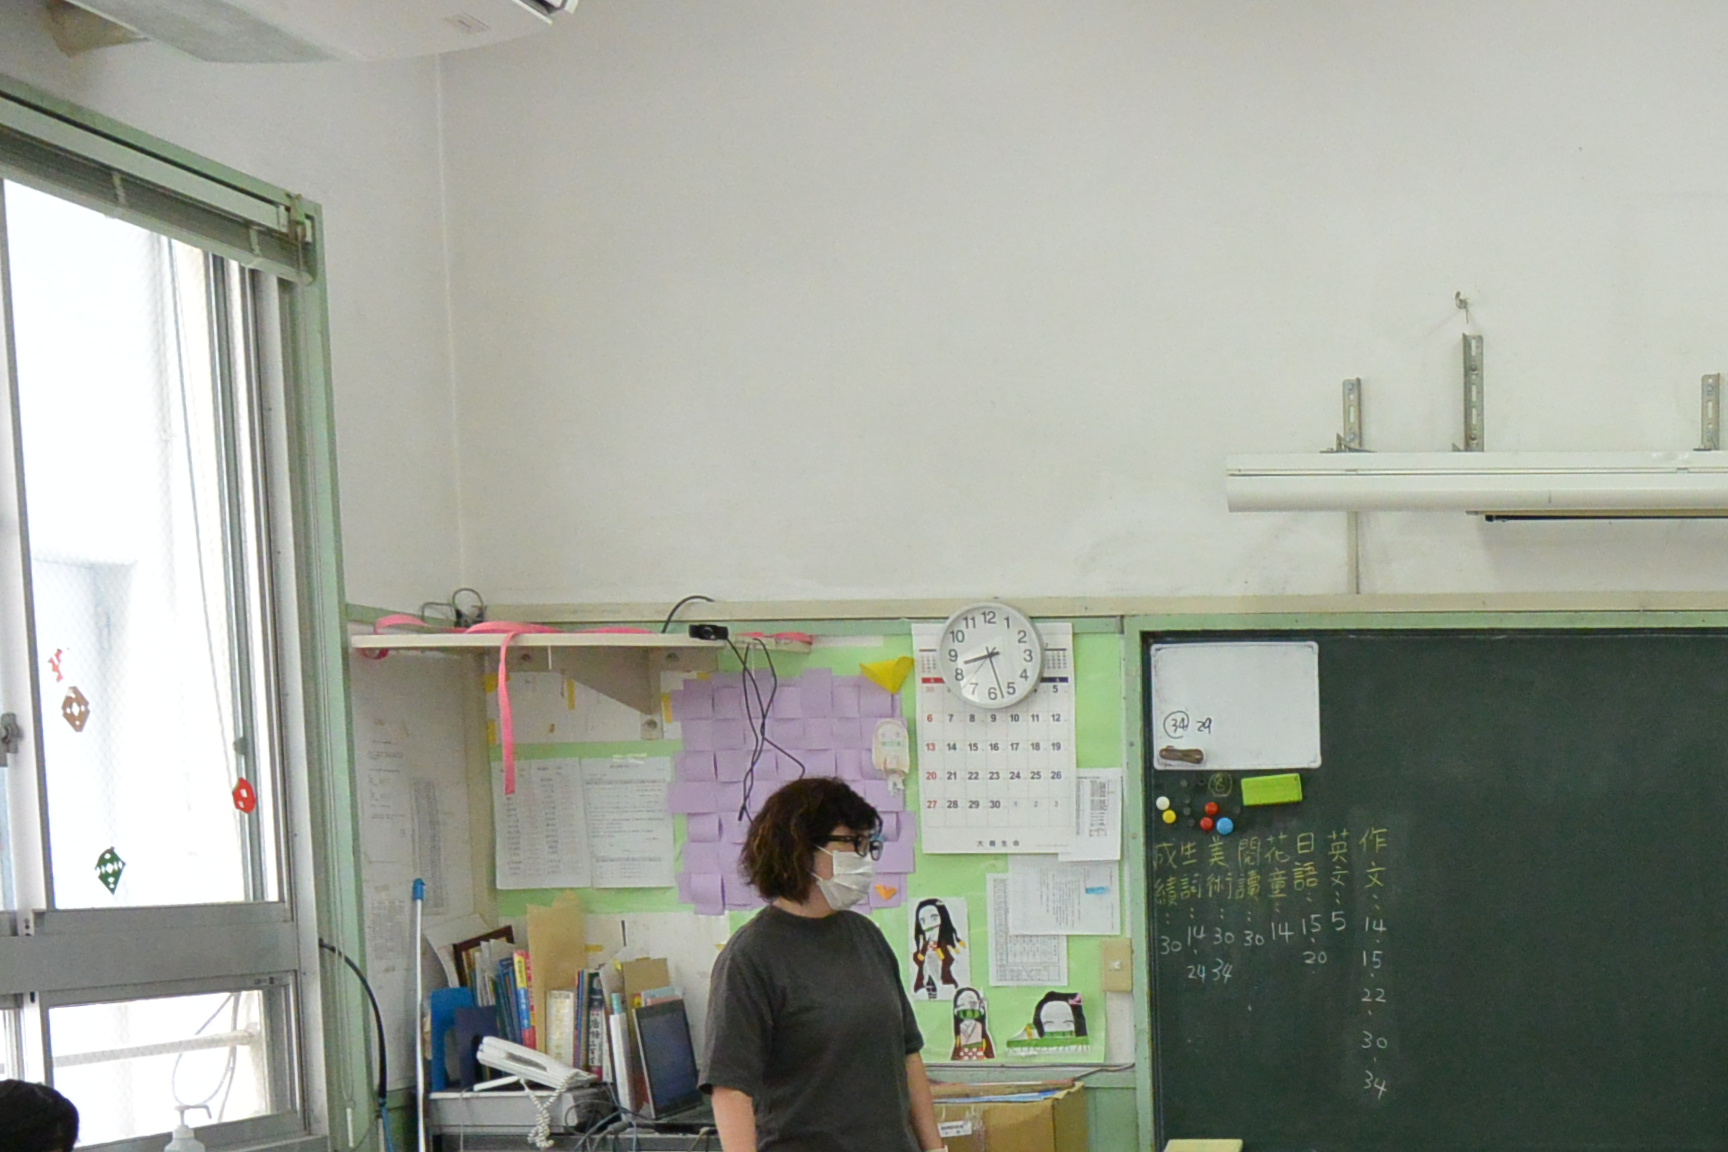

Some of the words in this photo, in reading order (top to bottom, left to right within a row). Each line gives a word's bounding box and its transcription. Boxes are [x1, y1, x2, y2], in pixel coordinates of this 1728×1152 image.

[963, 616, 976, 629] 11
[981, 611, 996, 624] 12
[1004, 616, 1010, 629] 1
[950, 630, 965, 643] 10
[1018, 630, 1027, 643] 2
[948, 649, 958, 662] 9
[1024, 649, 1033, 662] 3
[955, 668, 964, 681] 8
[1020, 669, 1029, 681] 4
[969, 682, 978, 695] 7
[988, 687, 998, 700] 6
[1007, 682, 1016, 695] 5
[927, 714, 933, 722] 6
[949, 714, 954, 722] 7
[969, 714, 976, 722] 8
[990, 714, 997, 722] 9
[1010, 714, 1020, 722] 10
[1031, 714, 1040, 722] 11
[1051, 714, 1061, 722] 12
[926, 743, 936, 751] 13
[947, 743, 957, 751] 14
[968, 743, 978, 751] 15
[989, 743, 999, 751] 16
[1010, 743, 1020, 751] 17
[1030, 743, 1040, 751] 18
[1051, 743, 1061, 751] 19
[926, 772, 937, 780] 20
[947, 772, 957, 780] 21
[968, 772, 979, 780] 22
[989, 772, 1000, 780] 23
[1010, 772, 1021, 780] 24
[1030, 772, 1041, 780] 25
[1051, 772, 1062, 780] 26
[927, 801, 937, 809] 27
[947, 801, 958, 809] 28
[968, 801, 980, 809] 29
[989, 801, 1001, 809] 30
[1332, 911, 1347, 931] 5
[1213, 927, 1234, 945] 30
[1243, 930, 1264, 946] 30
[1271, 922, 1294, 943] 14
[1160, 936, 1182, 954] 30
[1187, 966, 1206, 984] 24
[1211, 958, 1233, 982] 34
[1364, 1070, 1387, 1100] 34
